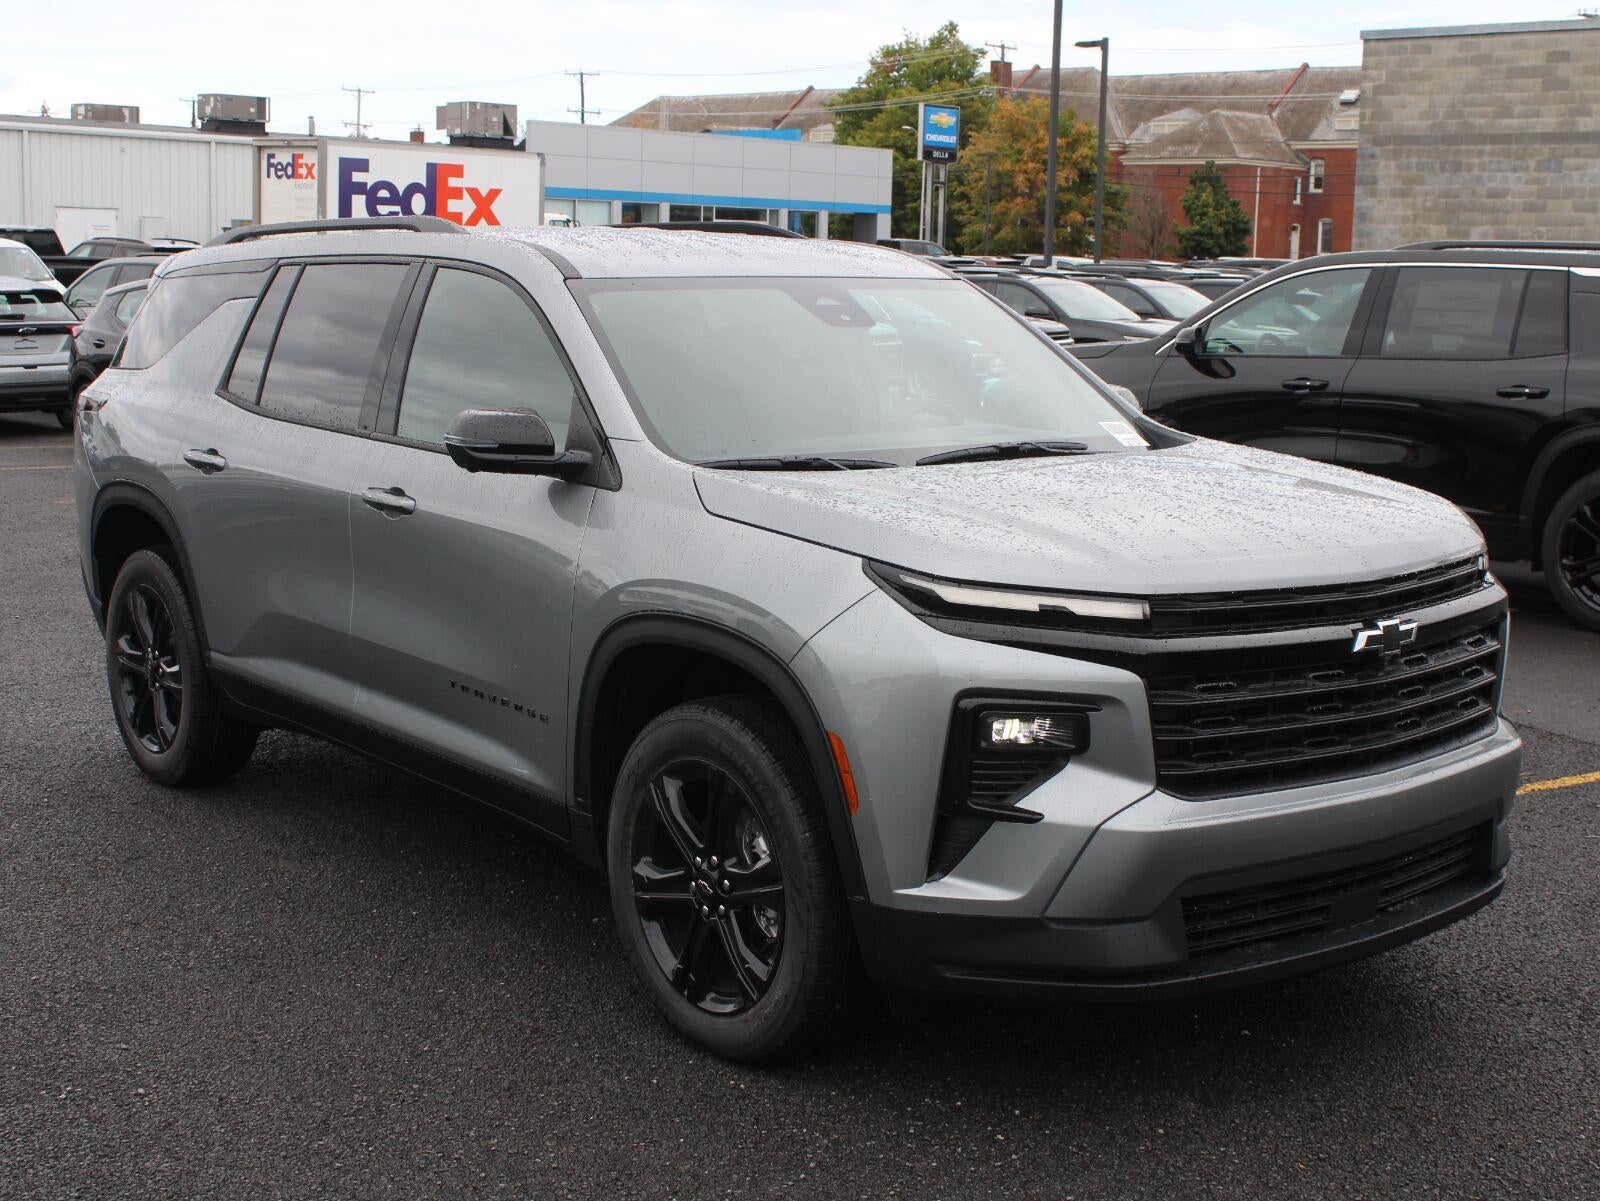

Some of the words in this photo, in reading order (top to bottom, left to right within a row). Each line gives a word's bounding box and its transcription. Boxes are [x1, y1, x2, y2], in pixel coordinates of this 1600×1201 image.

[925, 133, 957, 143] CHEVROLET
[266, 153, 316, 180] FedEx
[932, 150, 949, 159] DELLA
[338, 157, 503, 226] FedEx
[449, 679, 550, 724] TRAVERSE
